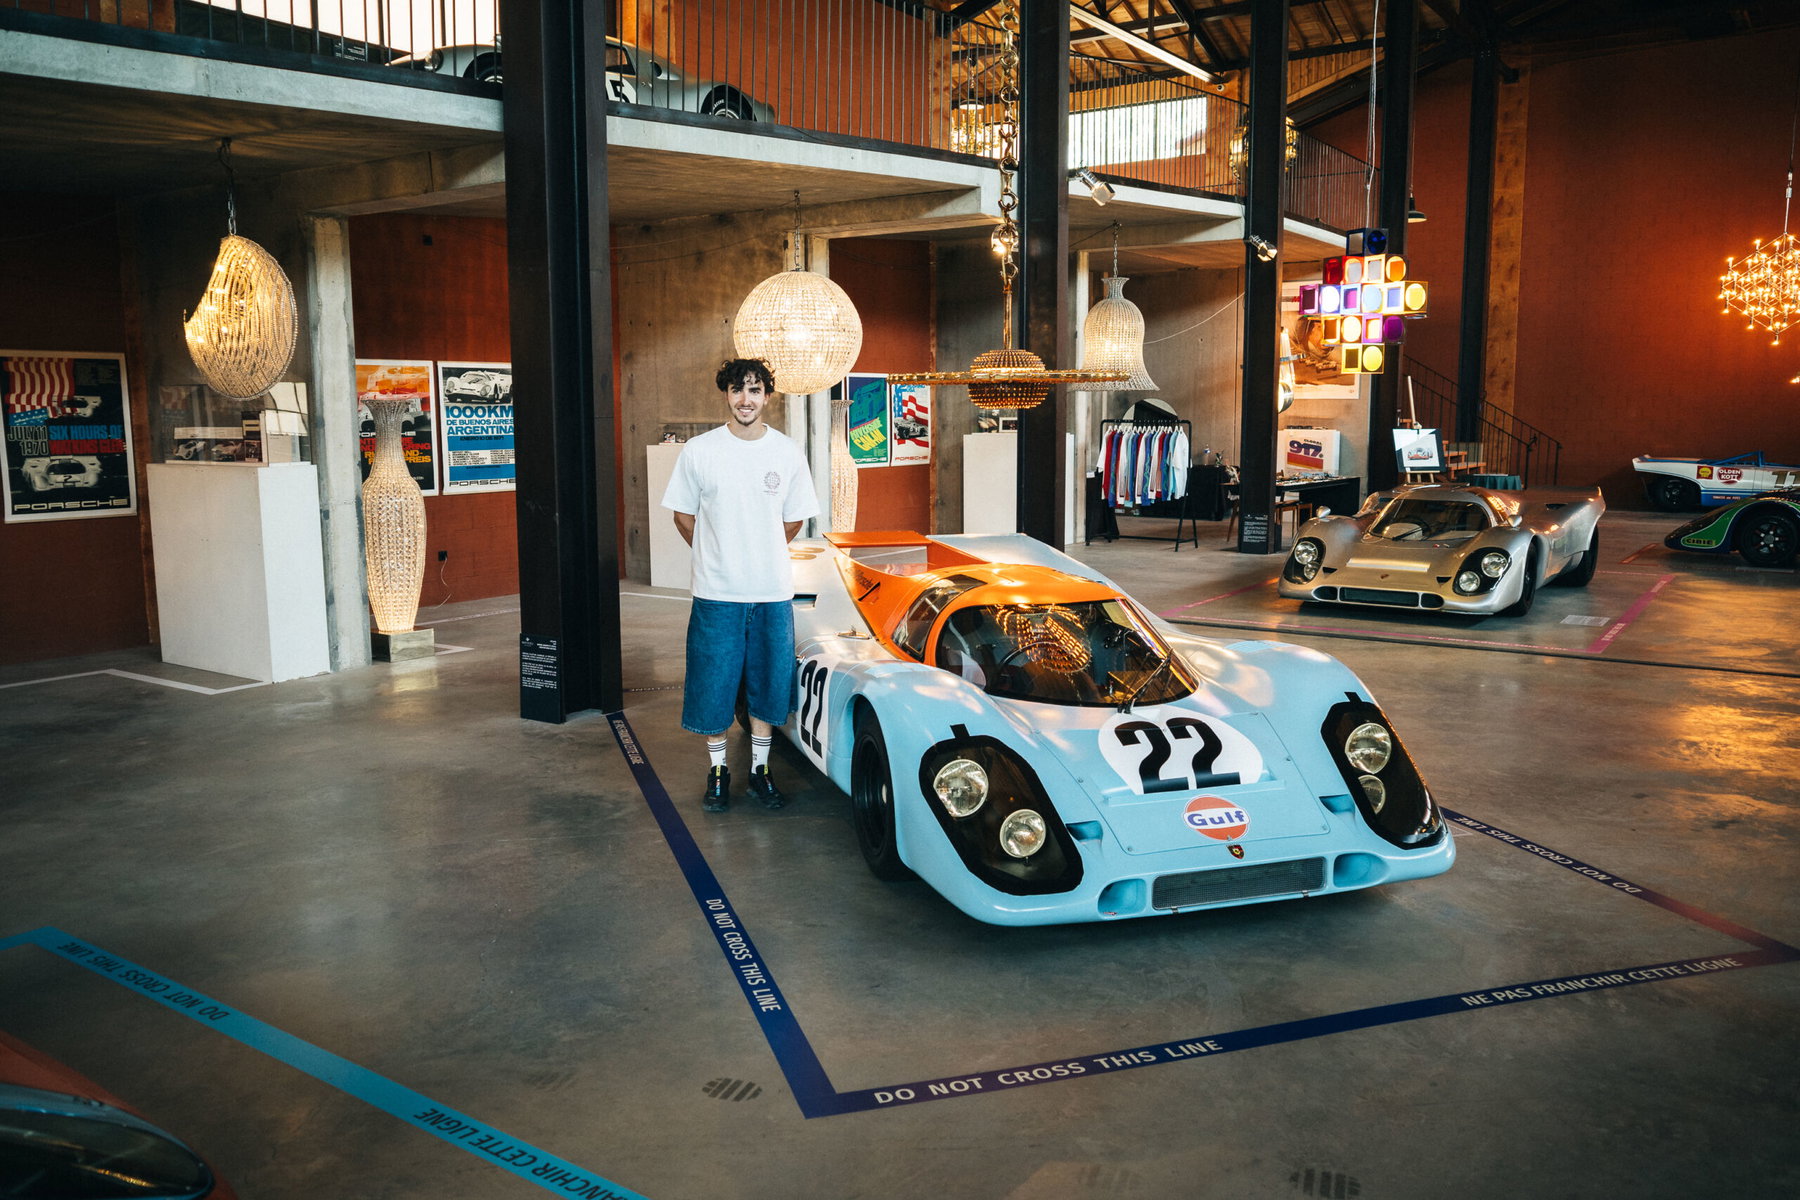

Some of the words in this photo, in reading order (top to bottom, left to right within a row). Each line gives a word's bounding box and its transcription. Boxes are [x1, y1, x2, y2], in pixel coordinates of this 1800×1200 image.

[8, 426, 34, 441] JULY
[35, 426, 48, 440] 11
[49, 425, 68, 441] SIX
[70, 425, 108, 441] HOURS
[109, 424, 123, 440] OF
[447, 425, 514, 436] ARGENTINA
[21, 440, 49, 456] 1970
[1289, 440, 1322, 457] 917
[449, 479, 516, 487] PORSCHE
[14, 499, 128, 511] PORSCHE
[801, 660, 828, 758] 22
[1114, 717, 1241, 794] 22
[1187, 810, 1245, 827] Gulf
[1455, 817, 1487, 830] LINE
[1487, 830, 1521, 844] THIS
[1521, 844, 1573, 865] CROSS
[1573, 866, 1611, 881] NOT
[1612, 882, 1642, 893] DO
[706, 899, 725, 910] DO
[713, 913, 736, 928] NOT
[57, 942, 93, 958] LINE
[723, 932, 752, 960] CROSS
[86, 955, 125, 973] THIS
[118, 969, 171, 993] CROSS
[740, 962, 766, 985] THIS
[1461, 992, 1493, 1006] NE
[1493, 988, 1532, 1003] PAS
[1531, 974, 1627, 996] FRANCHIR
[1628, 965, 1687, 982] CETTE
[1685, 957, 1744, 973] LIGNE
[162, 991, 204, 1008] NOT
[752, 988, 781, 1012] LINE
[197, 1006, 230, 1021] DO
[874, 1087, 916, 1104] DO
[928, 1077, 983, 1096] NOT
[997, 1062, 1087, 1086] CROSS
[1093, 1051, 1157, 1069] THIS
[1164, 1039, 1224, 1058] LINE
[413, 1108, 479, 1140] LIGNE
[468, 1134, 537, 1167] CETTE
[530, 1162, 627, 1200] ANCHIR
